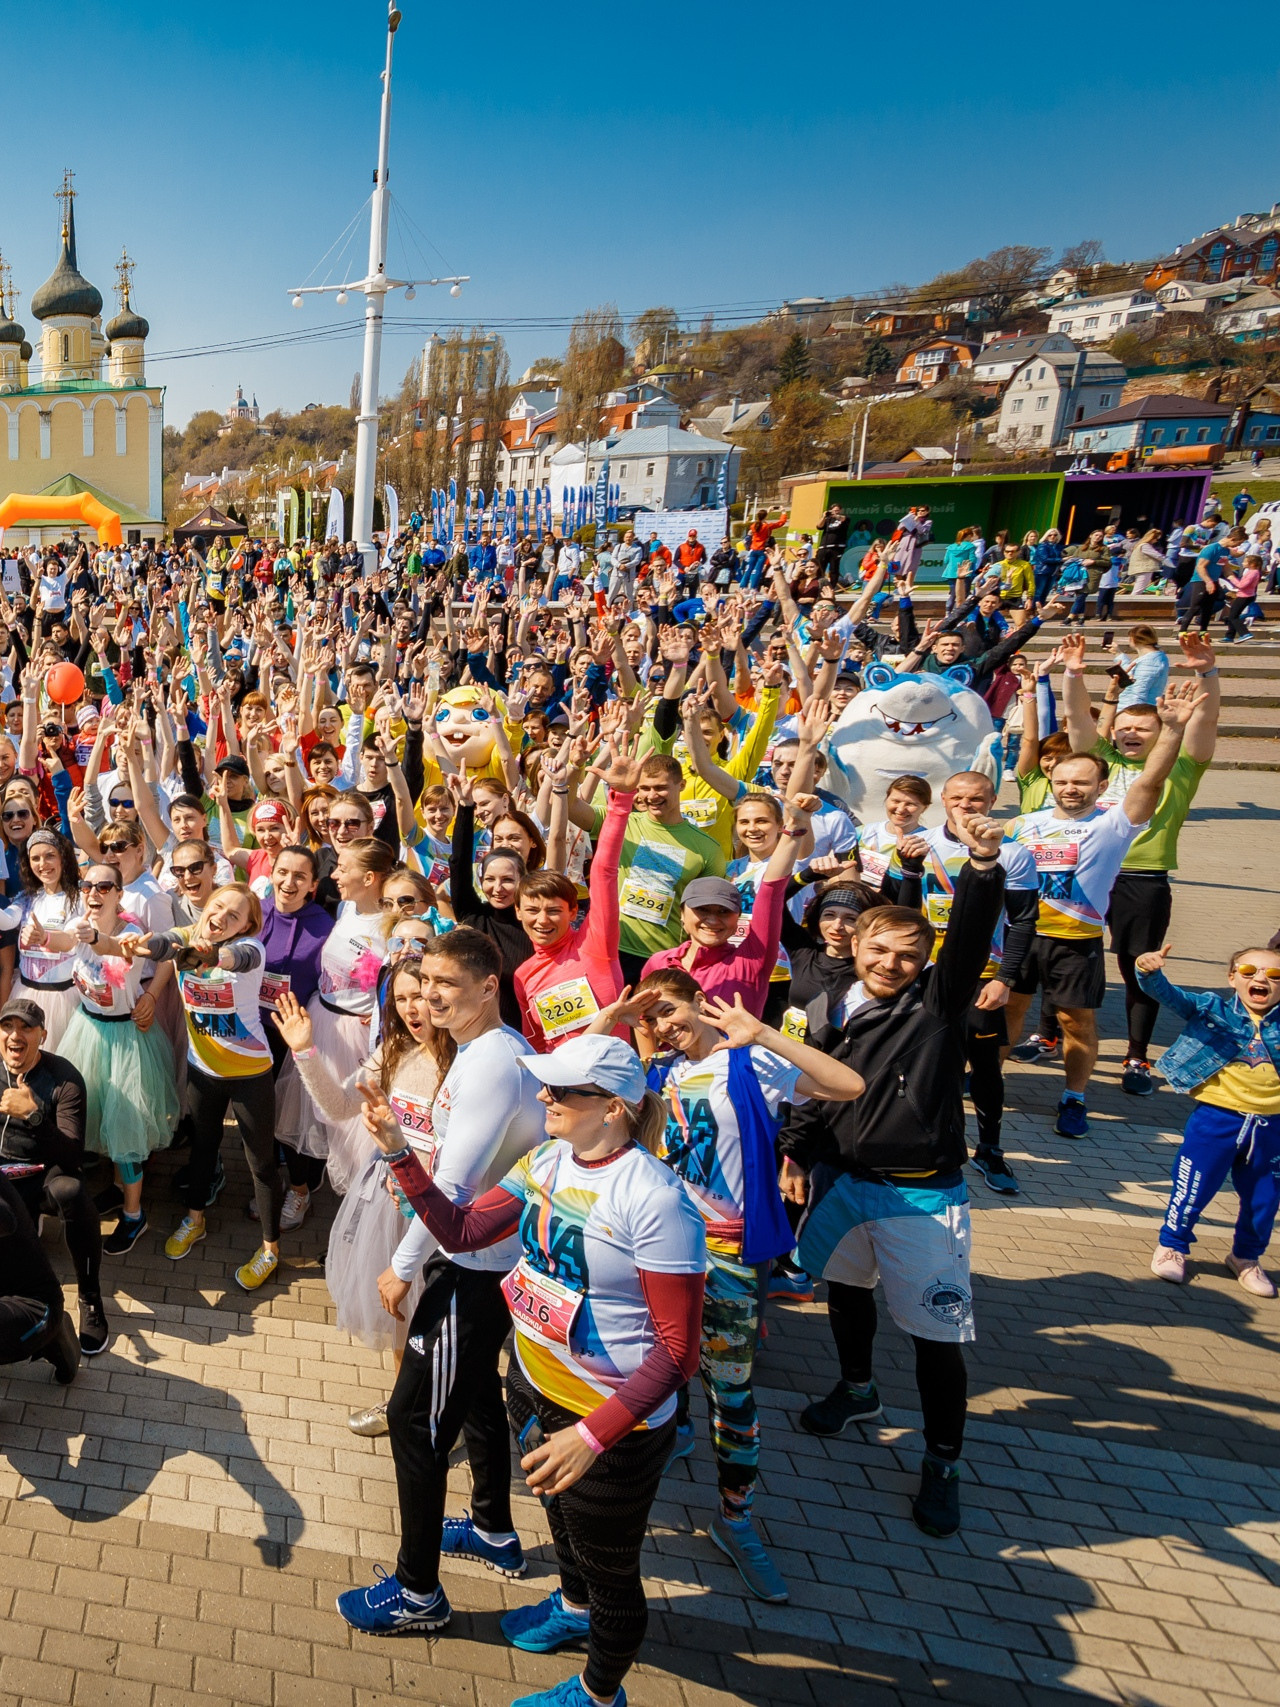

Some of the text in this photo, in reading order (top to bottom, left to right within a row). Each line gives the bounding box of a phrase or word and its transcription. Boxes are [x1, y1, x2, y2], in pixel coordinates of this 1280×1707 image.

[840, 503, 881, 514] мый
[1034, 850, 1065, 860] 684
[627, 893, 665, 912] 2294
[192, 990, 221, 1003] 511
[260, 985, 277, 997] 07
[545, 996, 586, 1021] 2202
[194, 1026, 237, 1038] RNRUN
[787, 1023, 807, 1039] 20
[402, 1112, 435, 1134] 877
[674, 1165, 711, 1188] RUN
[1172, 1155, 1193, 1207] DREAMING
[525, 1187, 535, 1198] 20
[512, 1285, 551, 1323] 716
[513, 1307, 544, 1333] НАДЕЖДА
[579, 1347, 595, 1358] 19
